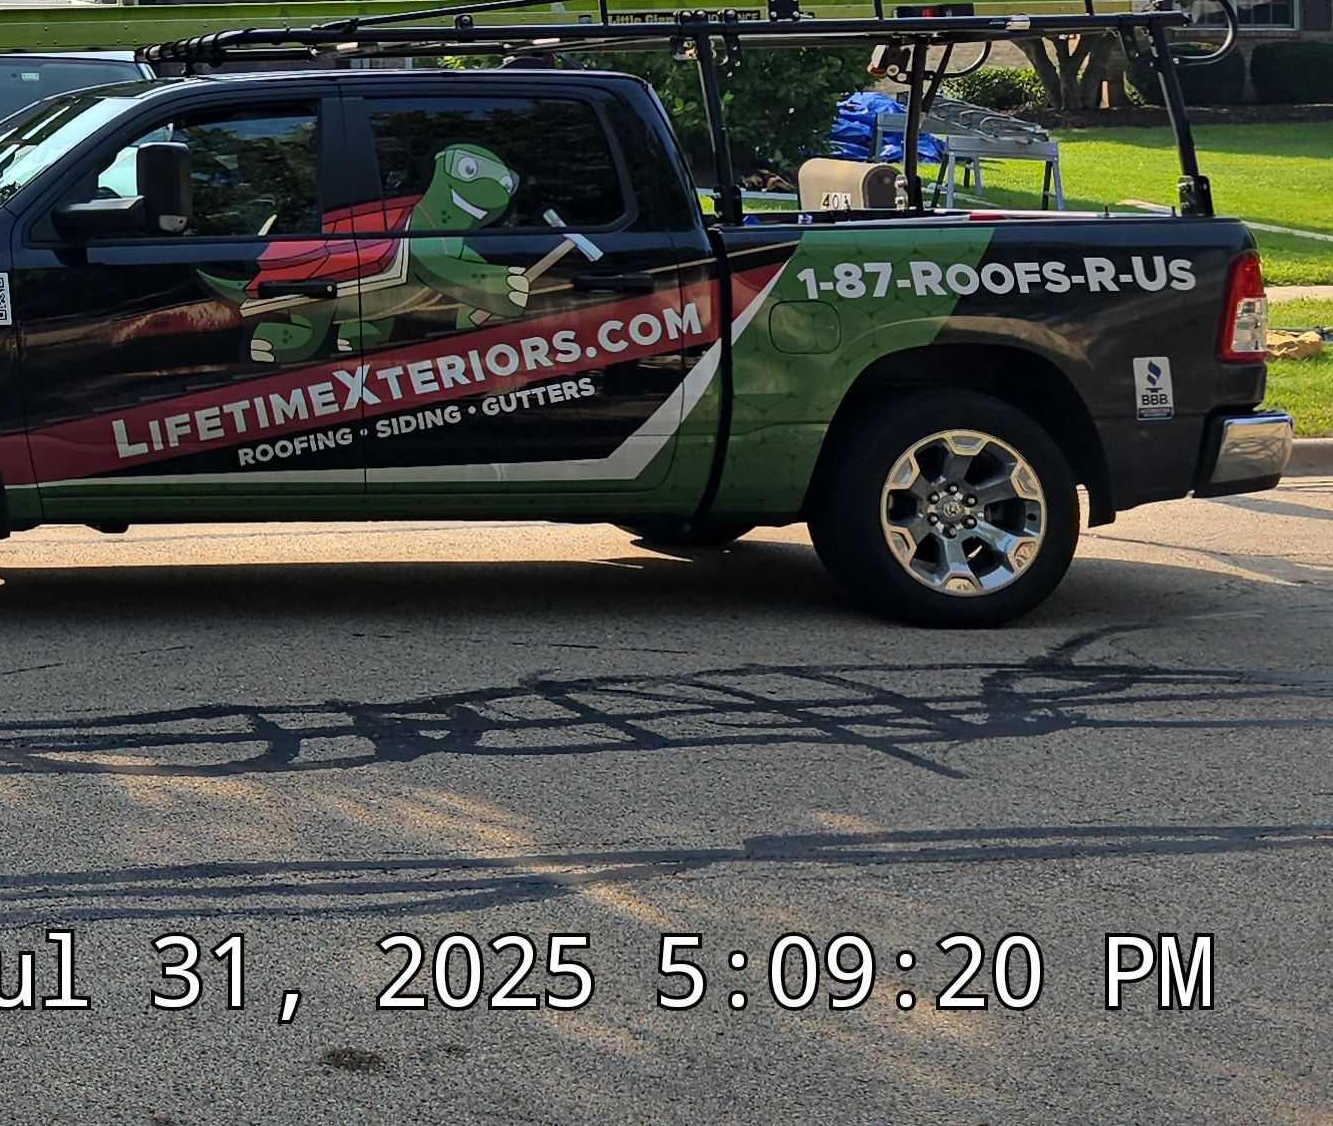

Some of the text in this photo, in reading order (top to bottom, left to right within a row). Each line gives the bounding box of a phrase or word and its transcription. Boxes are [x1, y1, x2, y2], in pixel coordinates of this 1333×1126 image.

[645, 14, 676, 24] Gian
[1141, 394, 1169, 406] BBB
[237, 377, 596, 467] ROOFING SIDING GUTTERS
